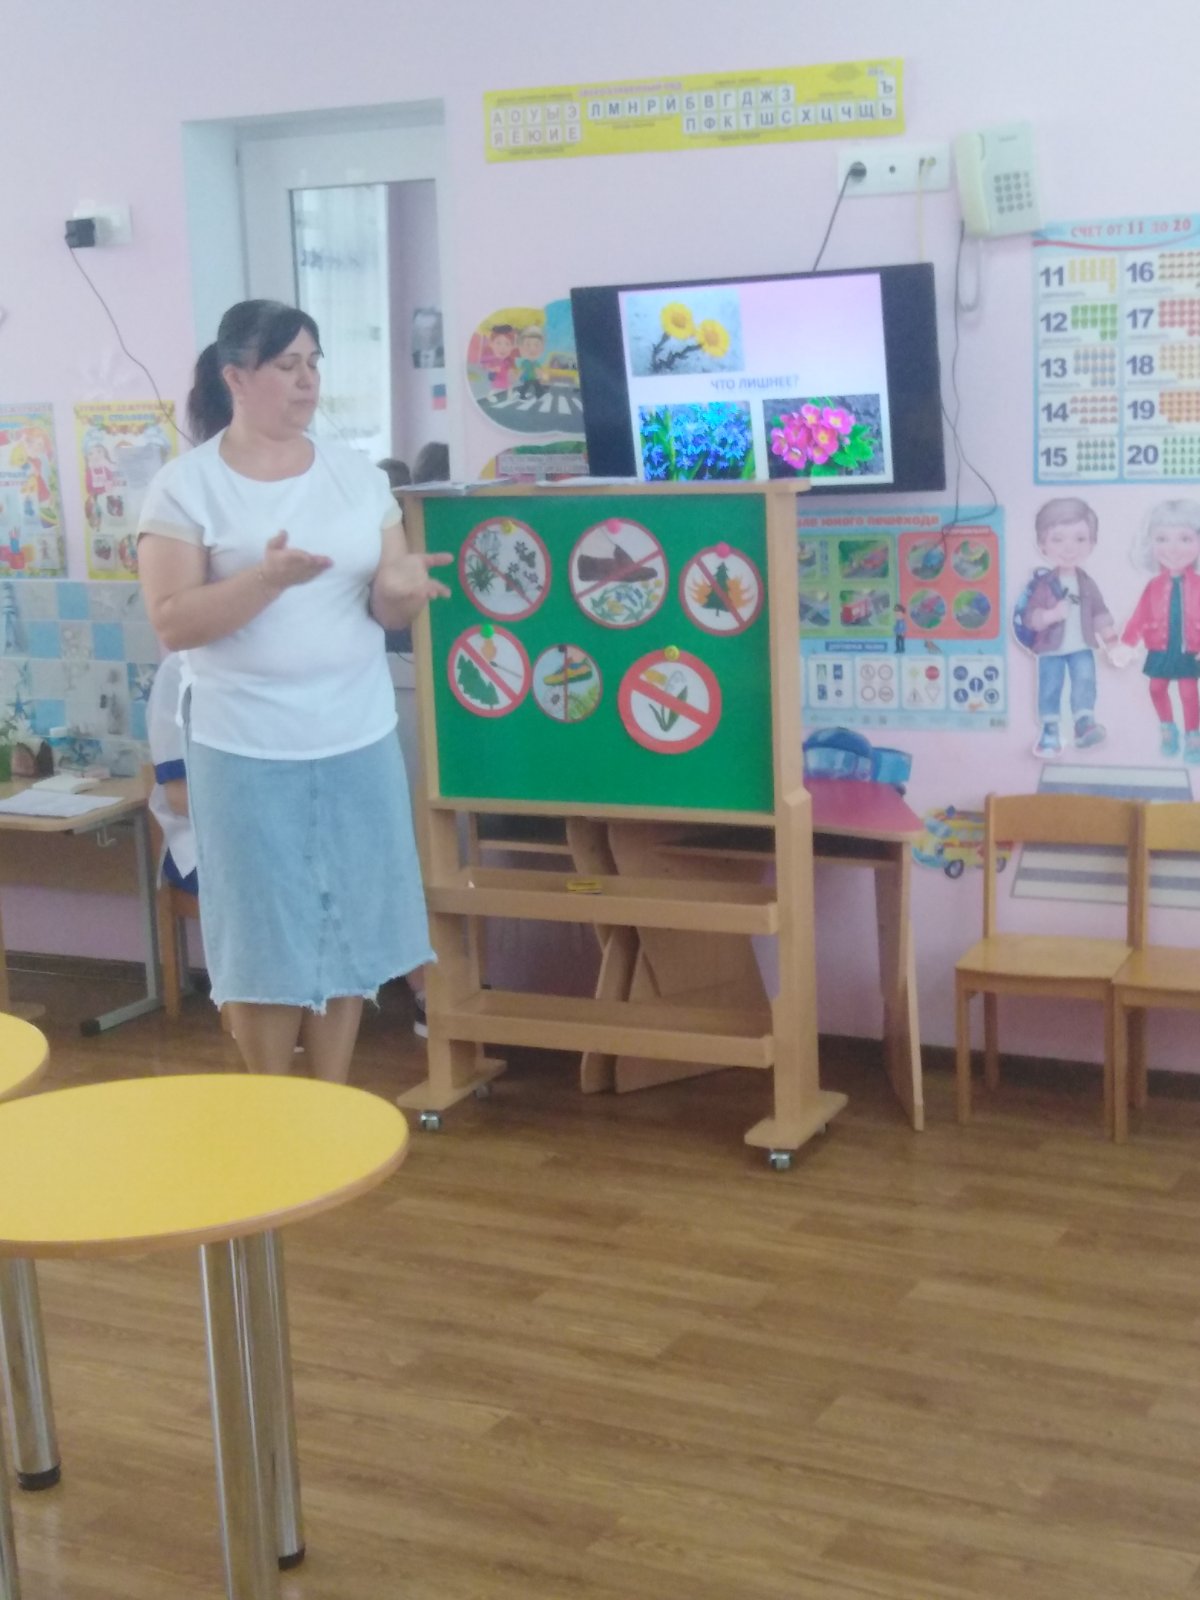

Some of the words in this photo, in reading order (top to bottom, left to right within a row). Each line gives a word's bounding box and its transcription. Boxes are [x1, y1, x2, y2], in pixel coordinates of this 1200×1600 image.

[1071, 225, 1103, 238] СЧЕТ
[1106, 223, 1124, 236] ОТ
[1128, 220, 1144, 235] 11
[1173, 218, 1191, 232] 20
[1040, 266, 1064, 287] 11
[1126, 262, 1154, 282] 16
[1040, 312, 1068, 332] 12
[1126, 309, 1154, 329] 17
[1040, 357, 1067, 378] 13
[1126, 355, 1154, 376] 18
[711, 378, 736, 390] ЧТО
[1041, 402, 1069, 422] 14
[1127, 400, 1155, 420] 19
[1040, 447, 1068, 467] 15
[1126, 445, 1158, 466] 20
